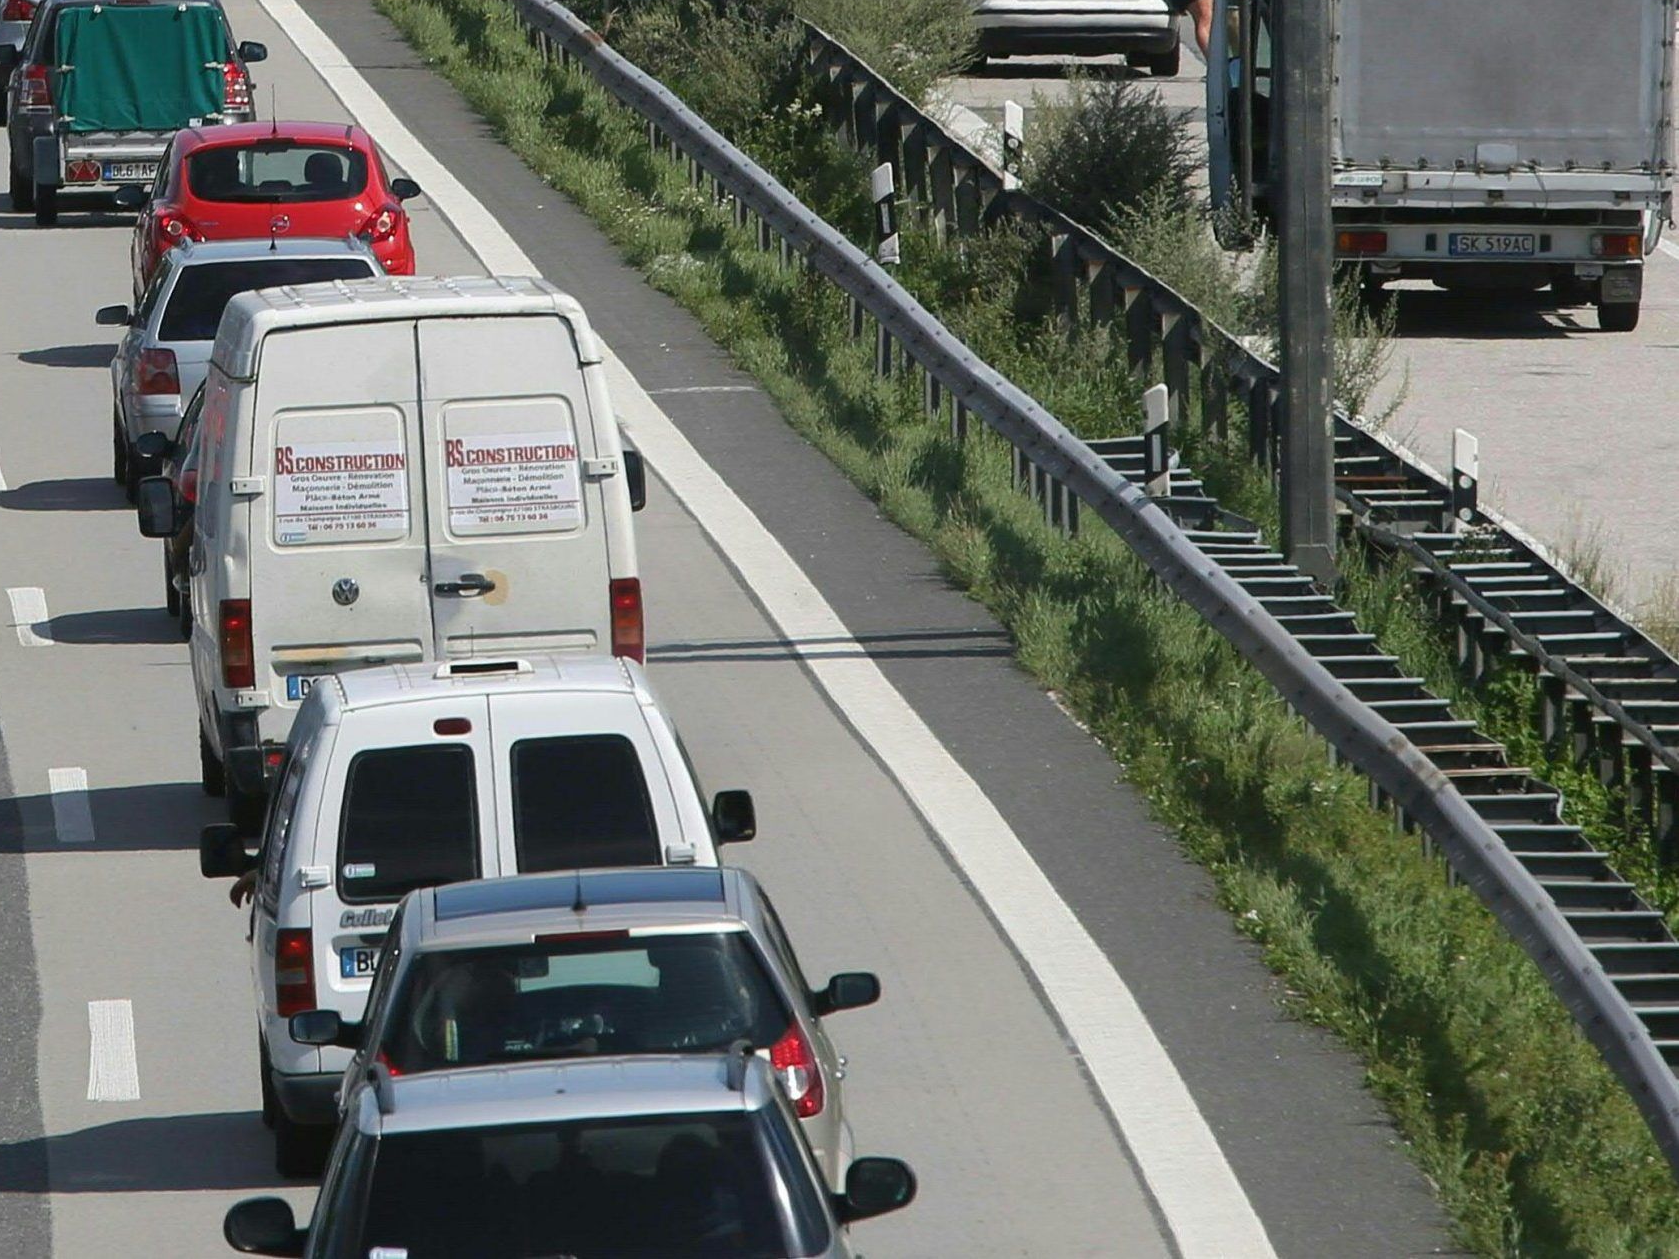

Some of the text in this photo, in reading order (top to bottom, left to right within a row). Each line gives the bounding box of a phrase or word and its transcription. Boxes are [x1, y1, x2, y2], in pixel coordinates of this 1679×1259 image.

[1459, 236, 1531, 251] SK 519AC
[446, 439, 575, 467] BS CONSTRUCTION
[276, 446, 405, 475] BS CONSTRUCTION
[518, 463, 566, 473] Rénovation
[290, 474, 311, 483] Gros
[347, 472, 395, 481] Rénovation
[518, 472, 564, 483] Démolition
[347, 481, 394, 491] Démolition
